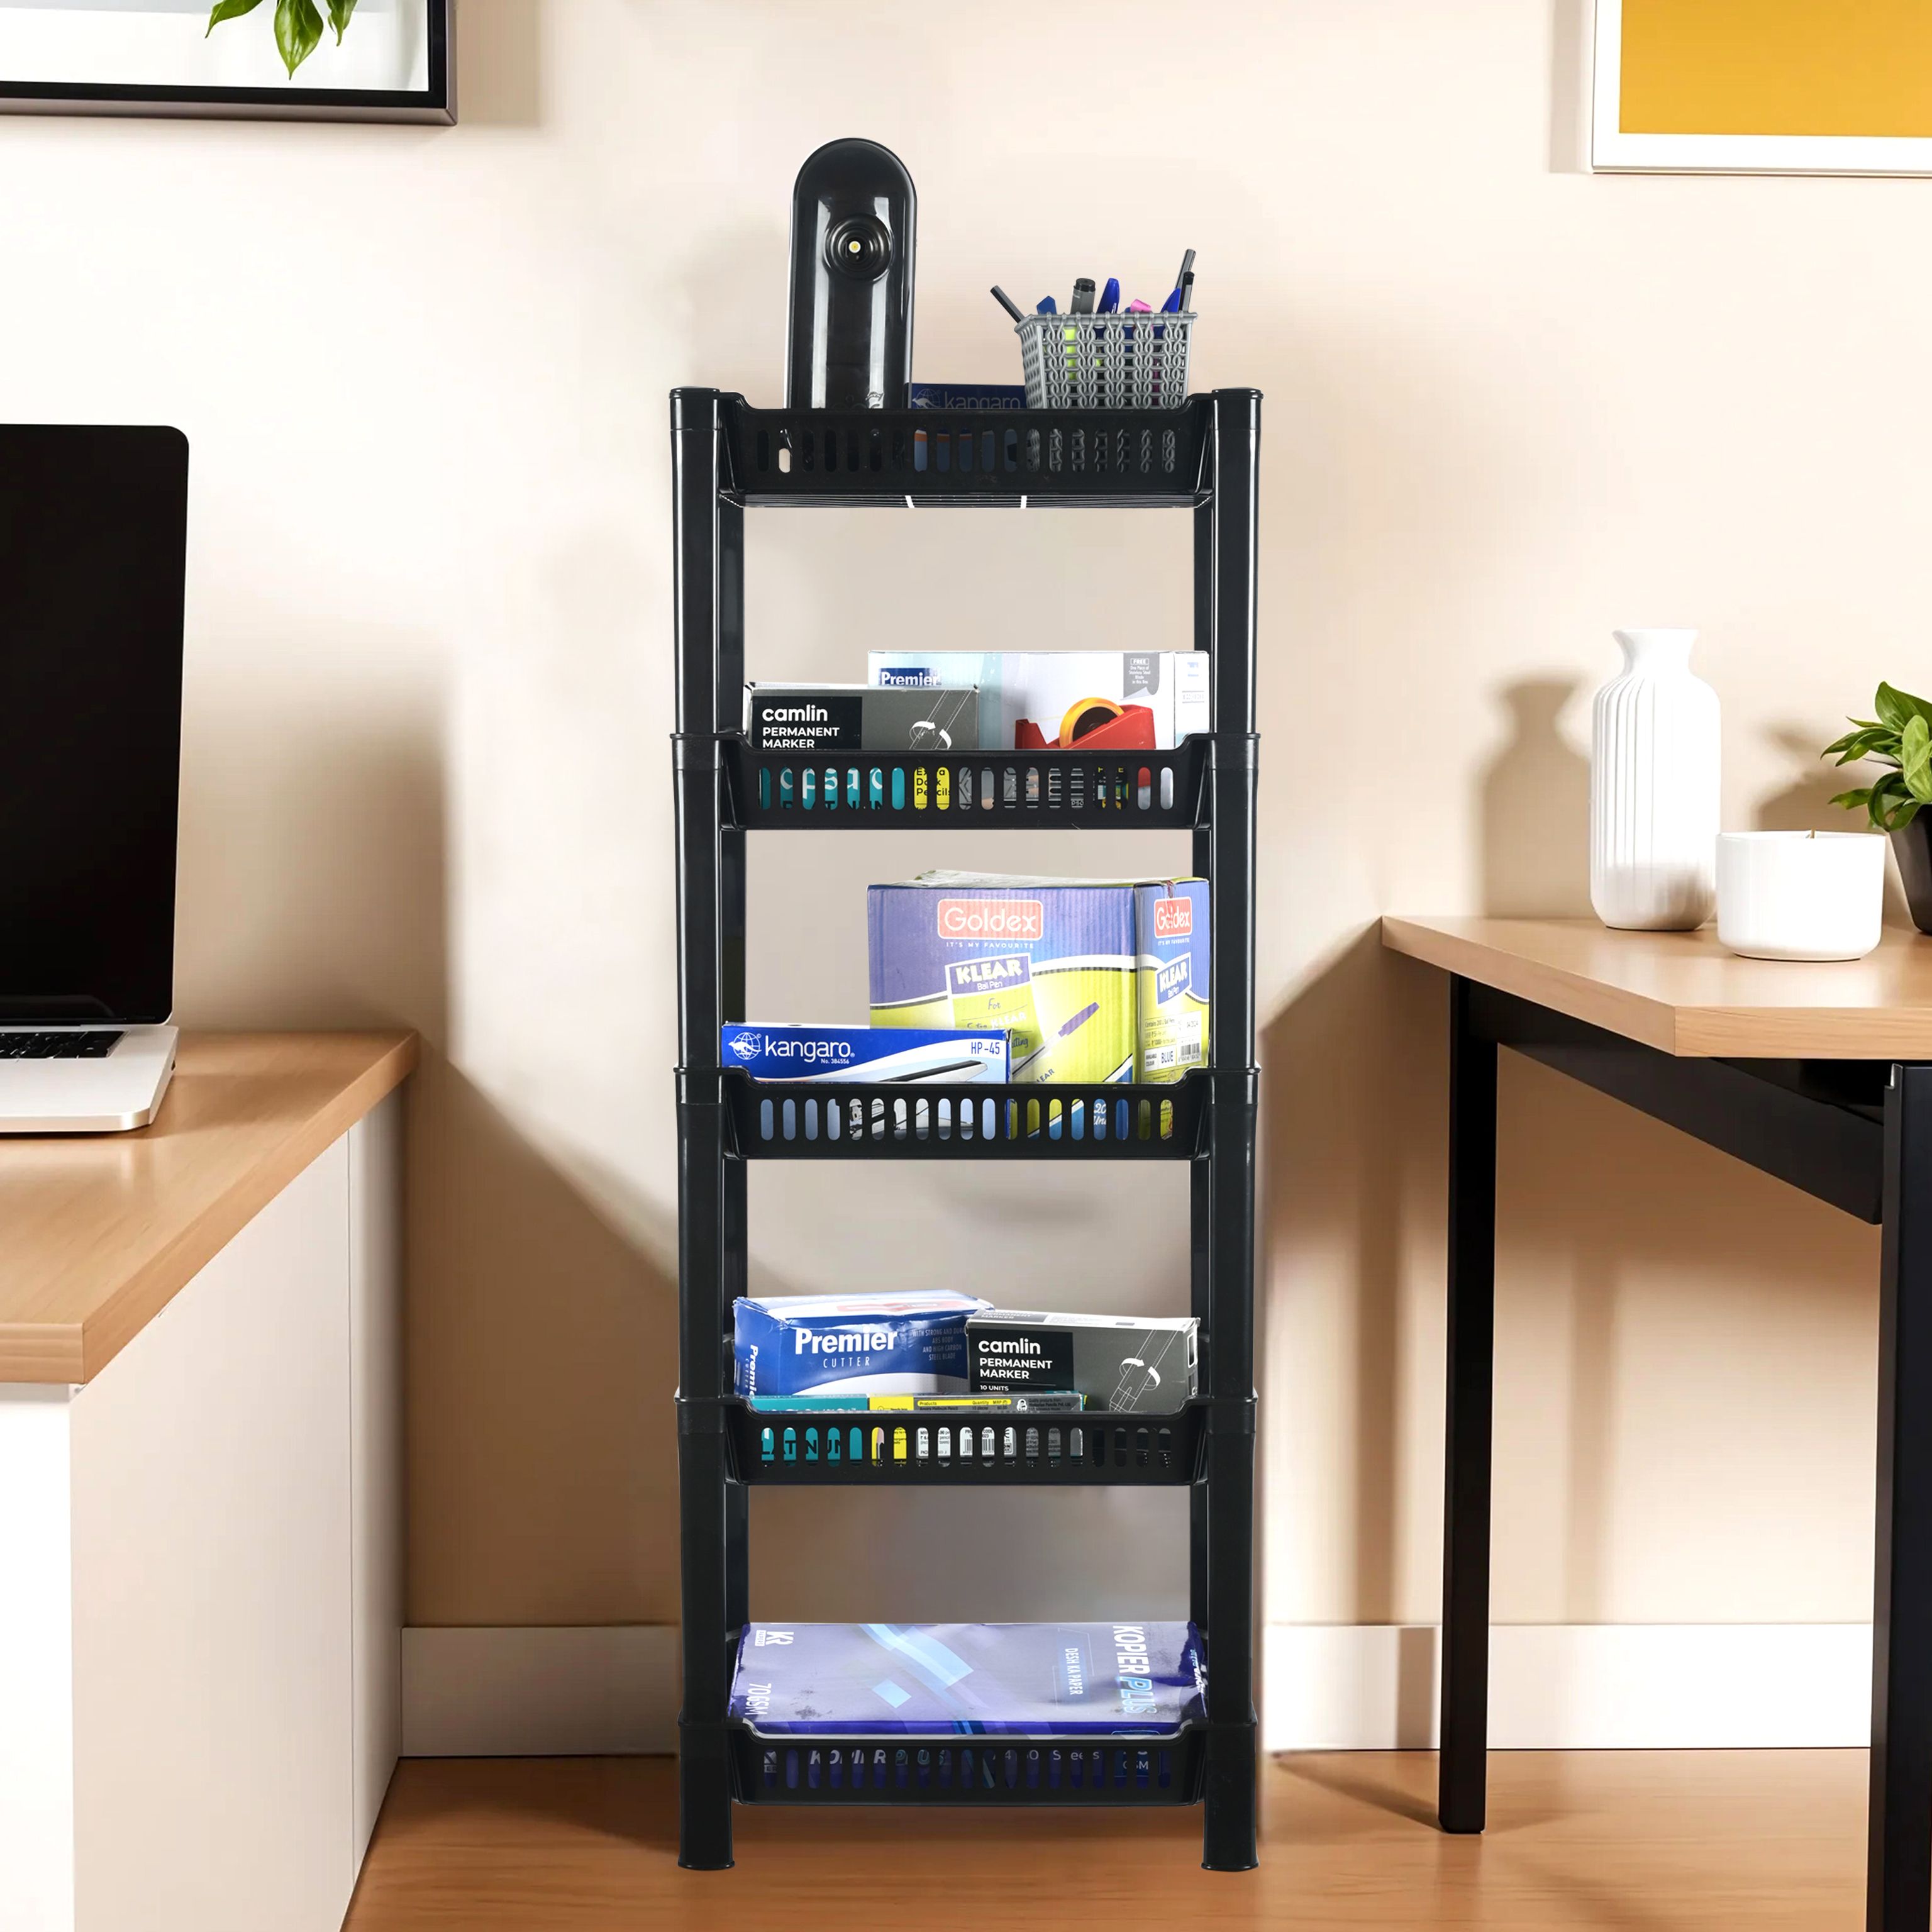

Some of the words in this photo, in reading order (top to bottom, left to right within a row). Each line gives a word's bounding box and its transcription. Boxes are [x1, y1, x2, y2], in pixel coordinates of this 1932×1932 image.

[881, 671, 939, 686] Premier
[762, 704, 828, 721] camlin
[763, 727, 840, 736] PERMANENT
[763, 739, 815, 748] MARKER
[945, 907, 1036, 932] Goldex
[956, 960, 1023, 985] KLEAR
[1159, 962, 1187, 992] KLEAR
[977, 982, 989, 991] Ball
[990, 981, 1003, 989] Pen
[988, 998, 1001, 1010] For
[1161, 1051, 1174, 1063] BLUE
[796, 1326, 897, 1355] Premier
[979, 1338, 1041, 1355] camlin
[823, 1357, 870, 1368] CUTTER
[980, 1358, 1053, 1368] PERMANENT
[980, 1369, 1030, 1379] MARKER
[765, 1631, 794, 1645] KR
[1065, 1648, 1080, 1664] DESH
[1113, 1626, 1150, 1674] KOPIER
[1067, 1665, 1081, 1675] KA
[1068, 1675, 1083, 1695] PAPER
[1119, 1676, 1158, 1714] PLUS
